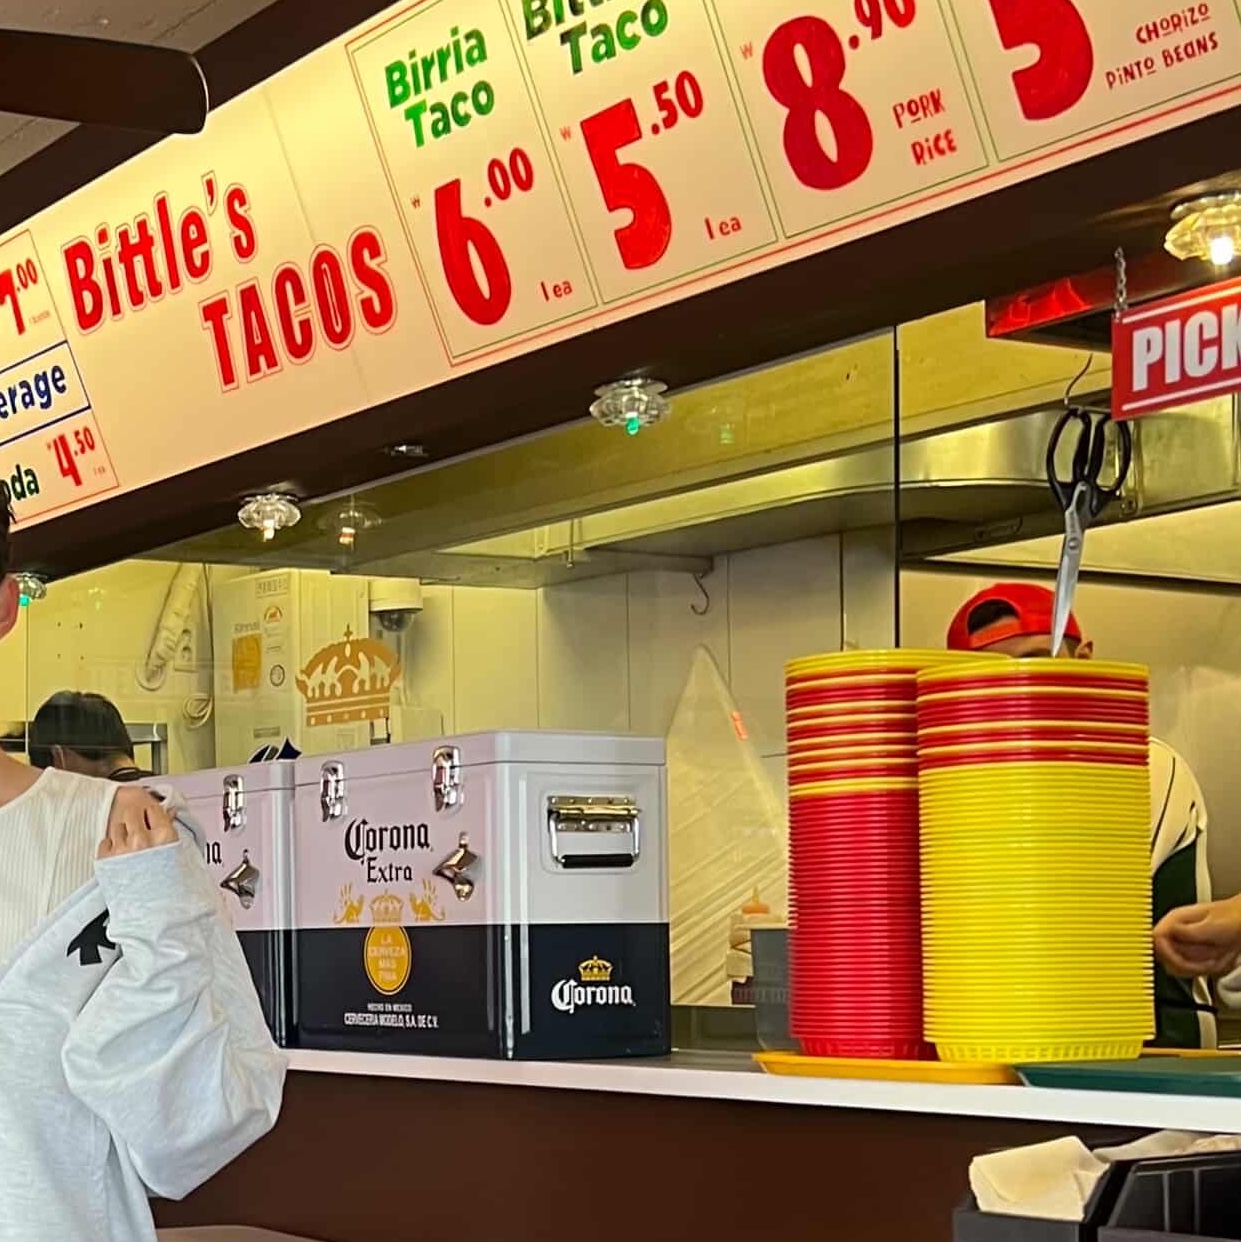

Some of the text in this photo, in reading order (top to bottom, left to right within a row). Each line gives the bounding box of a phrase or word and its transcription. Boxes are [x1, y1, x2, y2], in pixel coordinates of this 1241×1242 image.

[560, 0, 669, 75] Taco
[384, 25, 488, 111] Birria
[403, 80, 496, 149] Taco
[892, 87, 945, 129] PORK
[62, 177, 256, 333] Bittle's
[201, 230, 395, 388] TACOS
[0, 463, 41, 501] oda
[344, 818, 431, 866] Corona
[366, 860, 413, 884] Extra
[550, 979, 634, 1014] Corona
